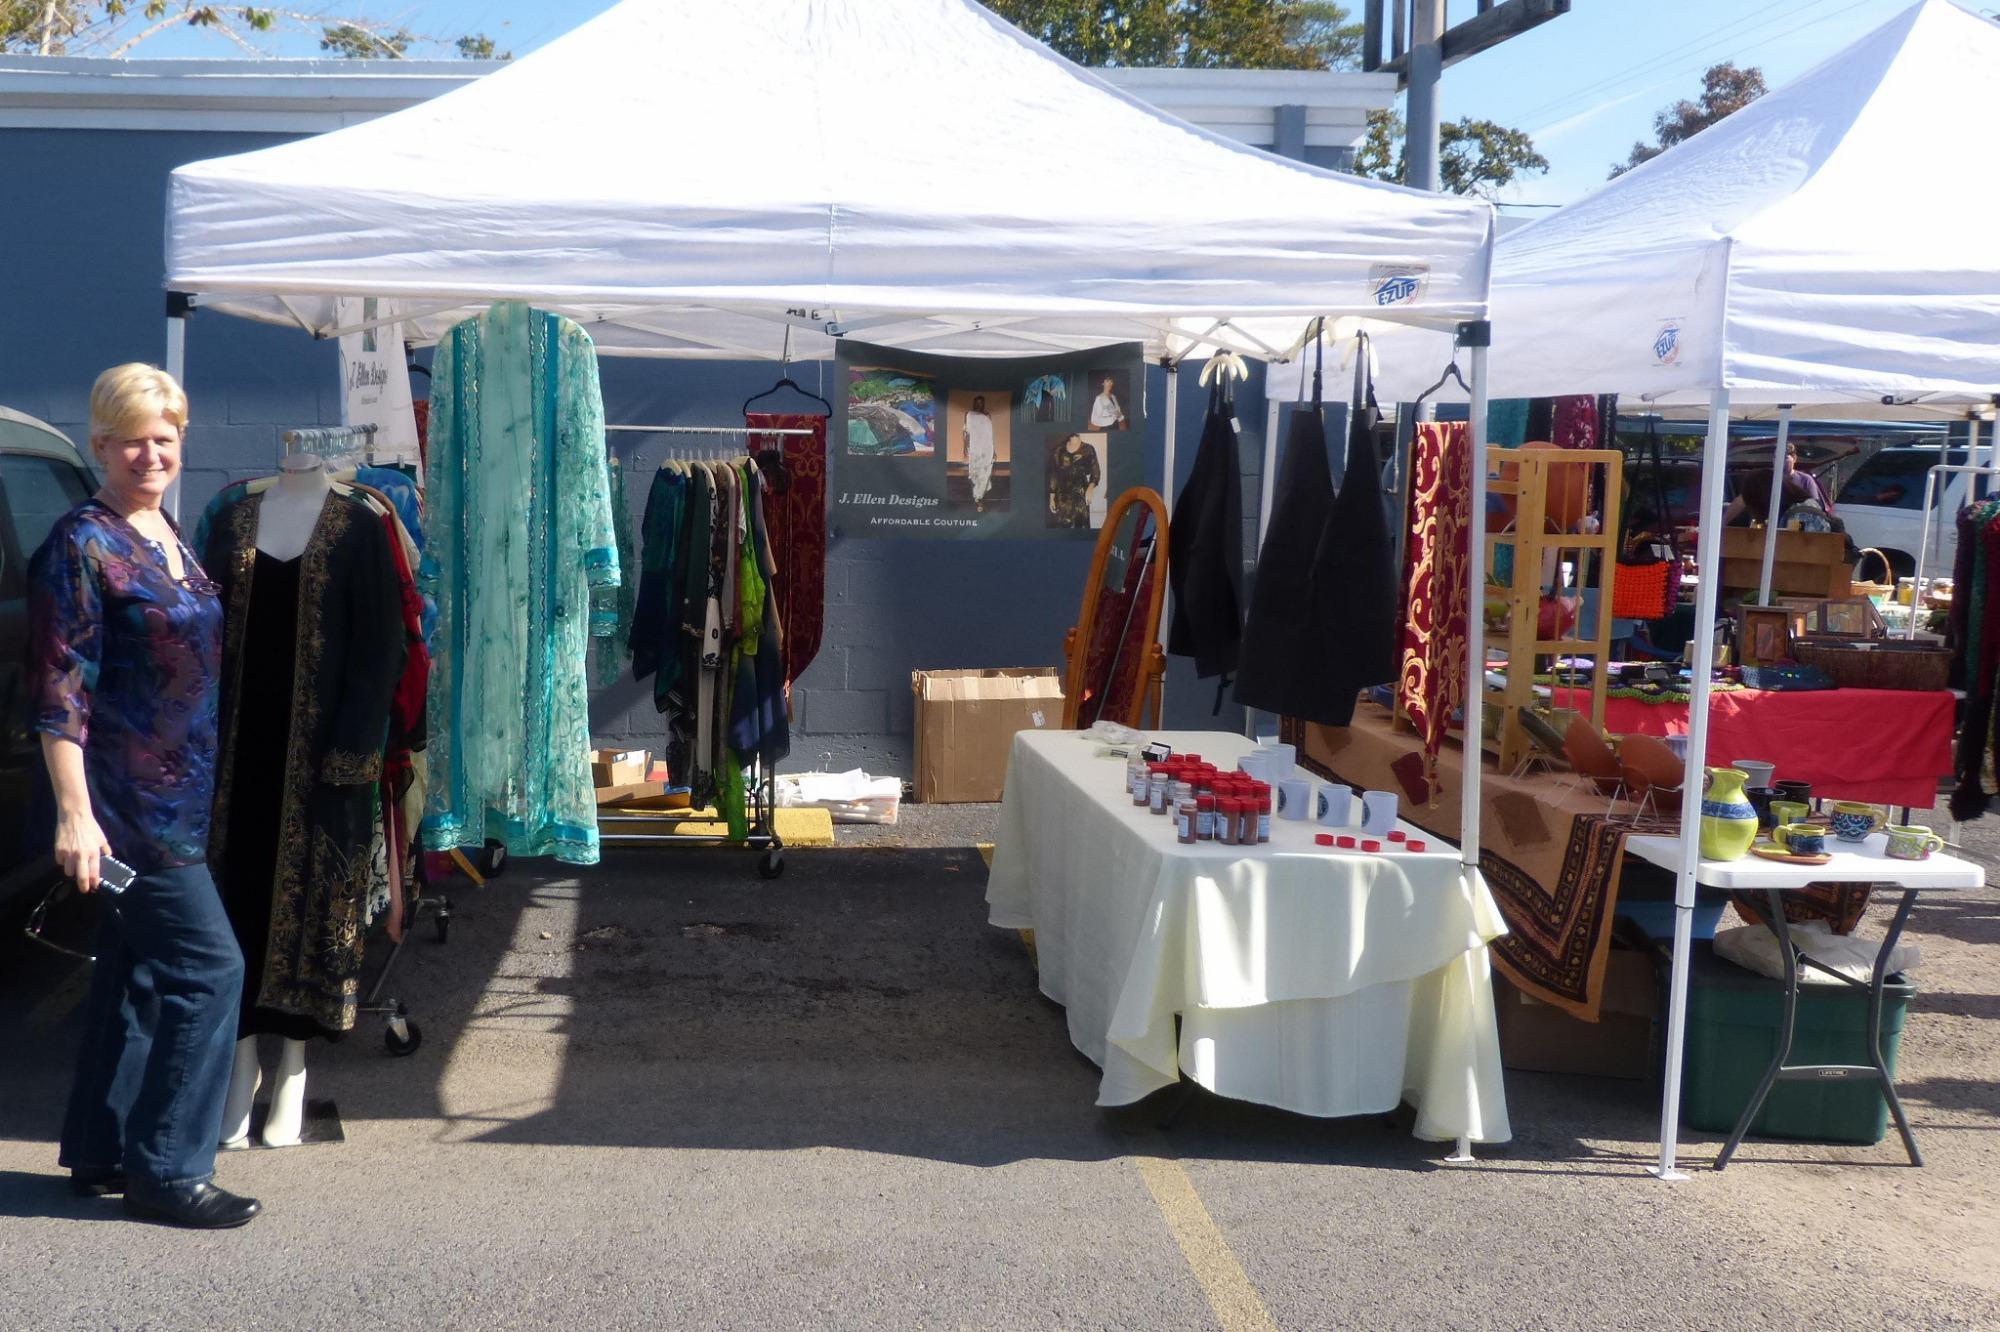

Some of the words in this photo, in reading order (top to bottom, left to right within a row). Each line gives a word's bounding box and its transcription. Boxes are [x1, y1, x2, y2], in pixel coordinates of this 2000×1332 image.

[838, 492, 850, 504] J.
[853, 493, 885, 505] Ellen
[888, 494, 939, 508] Designs
[870, 516, 930, 526] AFFORDABLE
[933, 518, 978, 527] COUTURE
